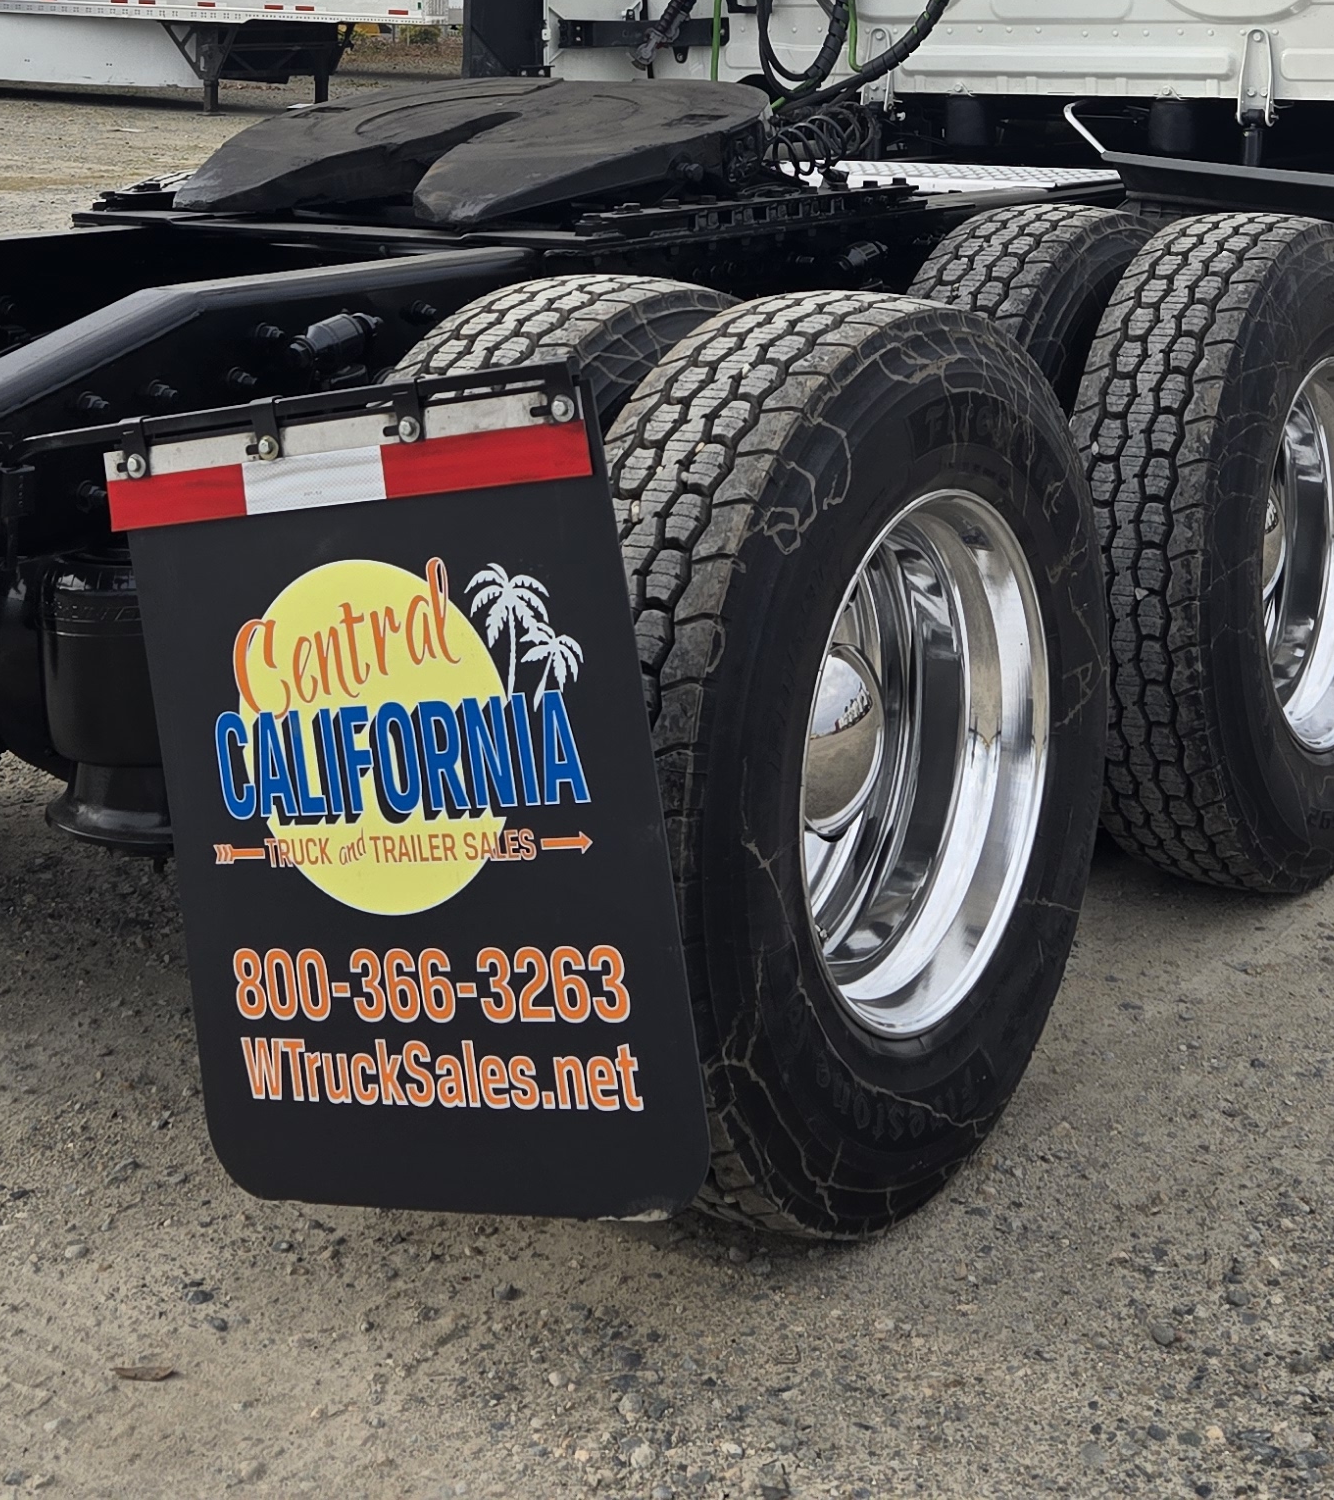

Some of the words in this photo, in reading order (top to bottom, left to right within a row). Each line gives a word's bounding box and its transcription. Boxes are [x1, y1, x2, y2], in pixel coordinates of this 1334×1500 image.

[232, 557, 461, 720] Central
[214, 689, 591, 823] CALIFORNIA
[264, 836, 331, 868] TRUCK
[338, 828, 367, 866] and
[369, 832, 457, 865] TRAILER
[463, 828, 537, 862] SALES
[233, 944, 631, 1024] 800-366-3263
[240, 1037, 644, 1112] WTruckSales.net
